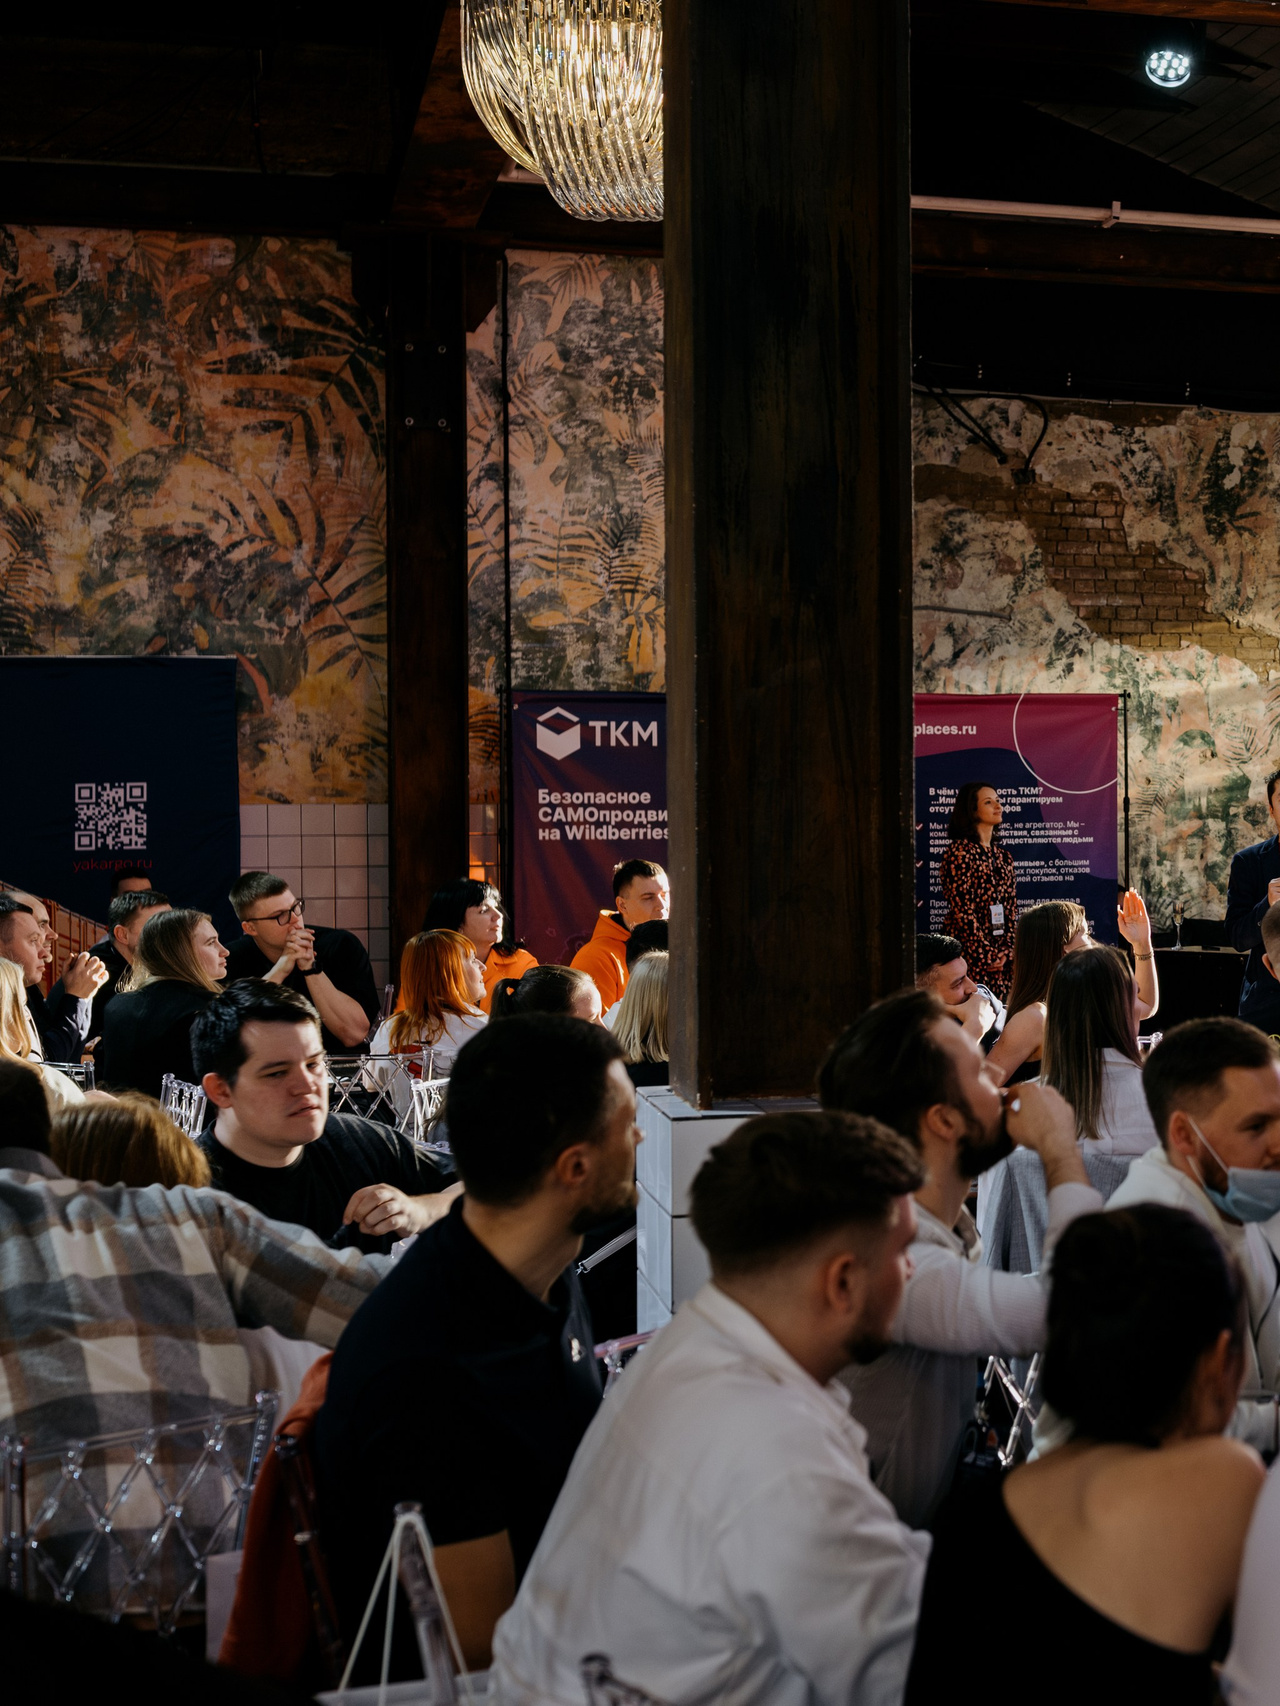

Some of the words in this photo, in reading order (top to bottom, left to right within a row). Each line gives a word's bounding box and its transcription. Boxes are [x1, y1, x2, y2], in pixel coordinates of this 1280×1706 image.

[588, 721, 658, 747] ТКМ
[914, 723, 977, 737] places.ru
[538, 788, 651, 804] Безопасное
[929, 787, 936, 796] В
[937, 786, 954, 796] чём
[996, 787, 1017, 795] ость
[1018, 787, 1043, 795] ТКМ?
[1007, 796, 1063, 805] гарантируем
[1025, 821, 1066, 830] агрегатор.
[1067, 820, 1079, 828] Мы
[538, 828, 561, 841] на
[1000, 836, 1061, 846] уществляются
[1062, 836, 1094, 844] людьми
[1054, 858, 1090, 866] большим
[1026, 867, 1059, 875] покупок,
